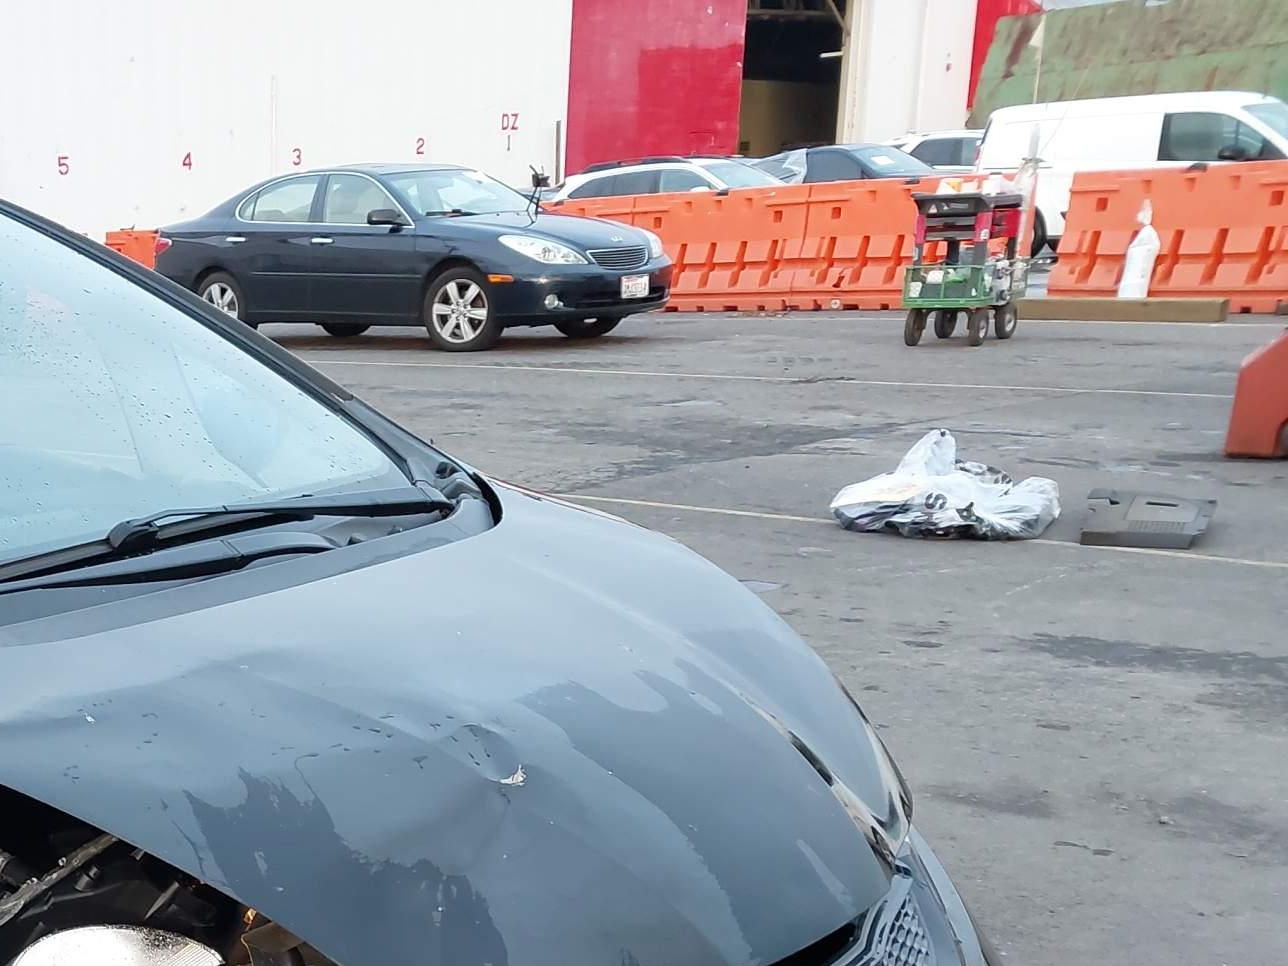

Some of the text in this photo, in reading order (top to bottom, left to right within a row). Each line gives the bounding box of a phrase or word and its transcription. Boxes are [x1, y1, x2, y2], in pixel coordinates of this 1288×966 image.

[500, 112, 520, 131] DZ
[415, 137, 425, 155] 2
[57, 155, 70, 176] 5
[181, 151, 193, 171] 4
[291, 147, 302, 167] 3
